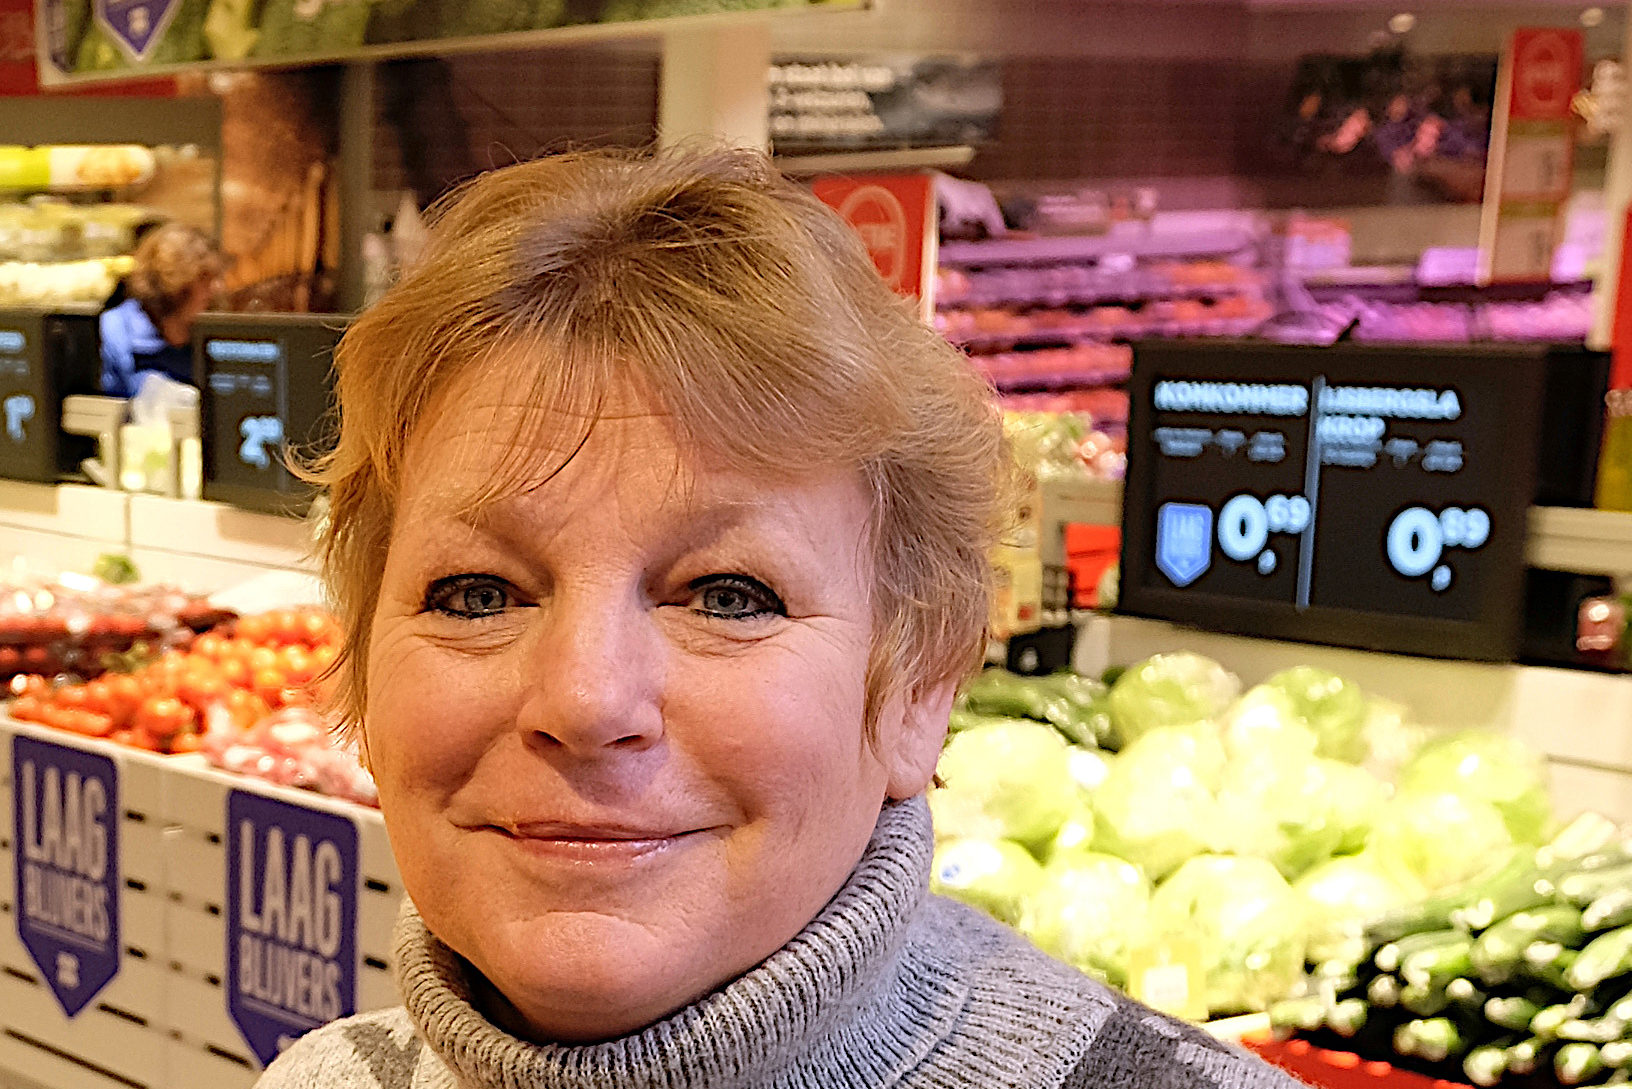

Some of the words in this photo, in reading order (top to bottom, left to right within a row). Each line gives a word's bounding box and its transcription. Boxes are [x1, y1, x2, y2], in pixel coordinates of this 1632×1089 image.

[1317, 416, 1386, 443] KROP
[22, 759, 108, 880] LAAG
[24, 863, 110, 943] BLIJVERS
[239, 818, 343, 959] LAAG
[239, 931, 343, 1023] BLIJVERS
